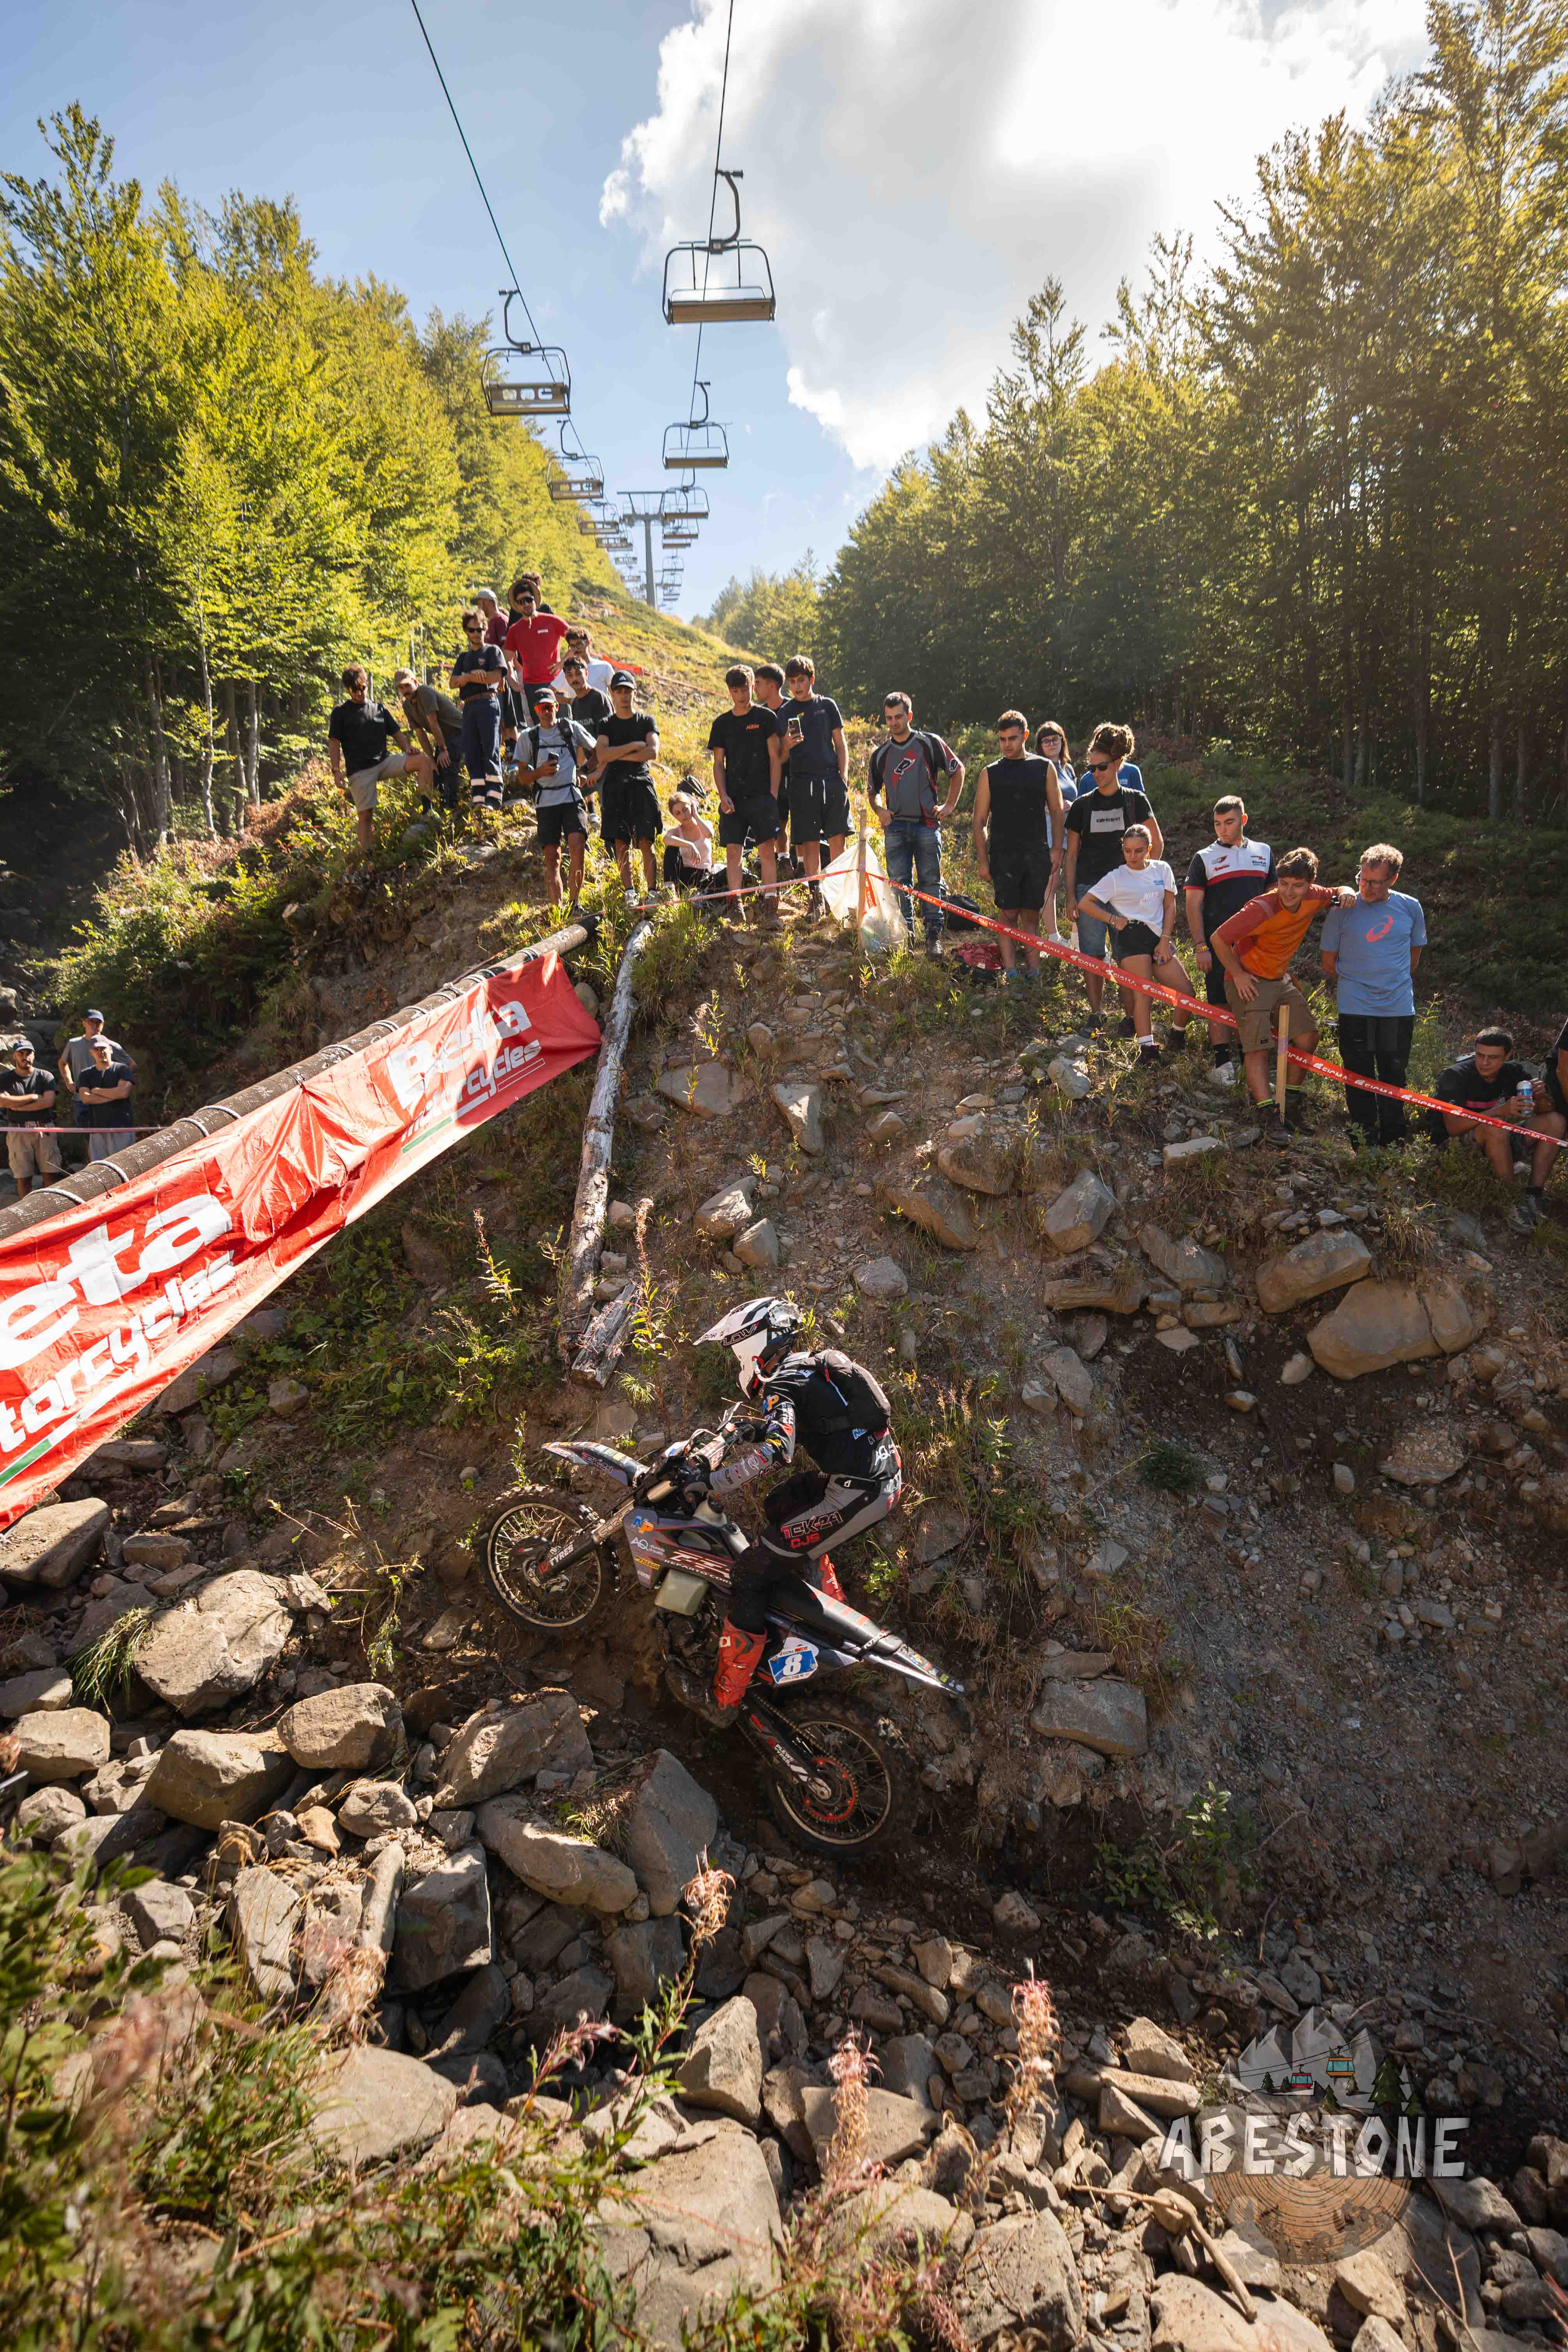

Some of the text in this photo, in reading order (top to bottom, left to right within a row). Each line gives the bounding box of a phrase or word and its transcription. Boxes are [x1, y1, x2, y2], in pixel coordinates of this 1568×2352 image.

[385, 1001, 532, 1110] Beta
[631, 1515, 654, 1534] NP
[783, 1653, 803, 1676] 8
